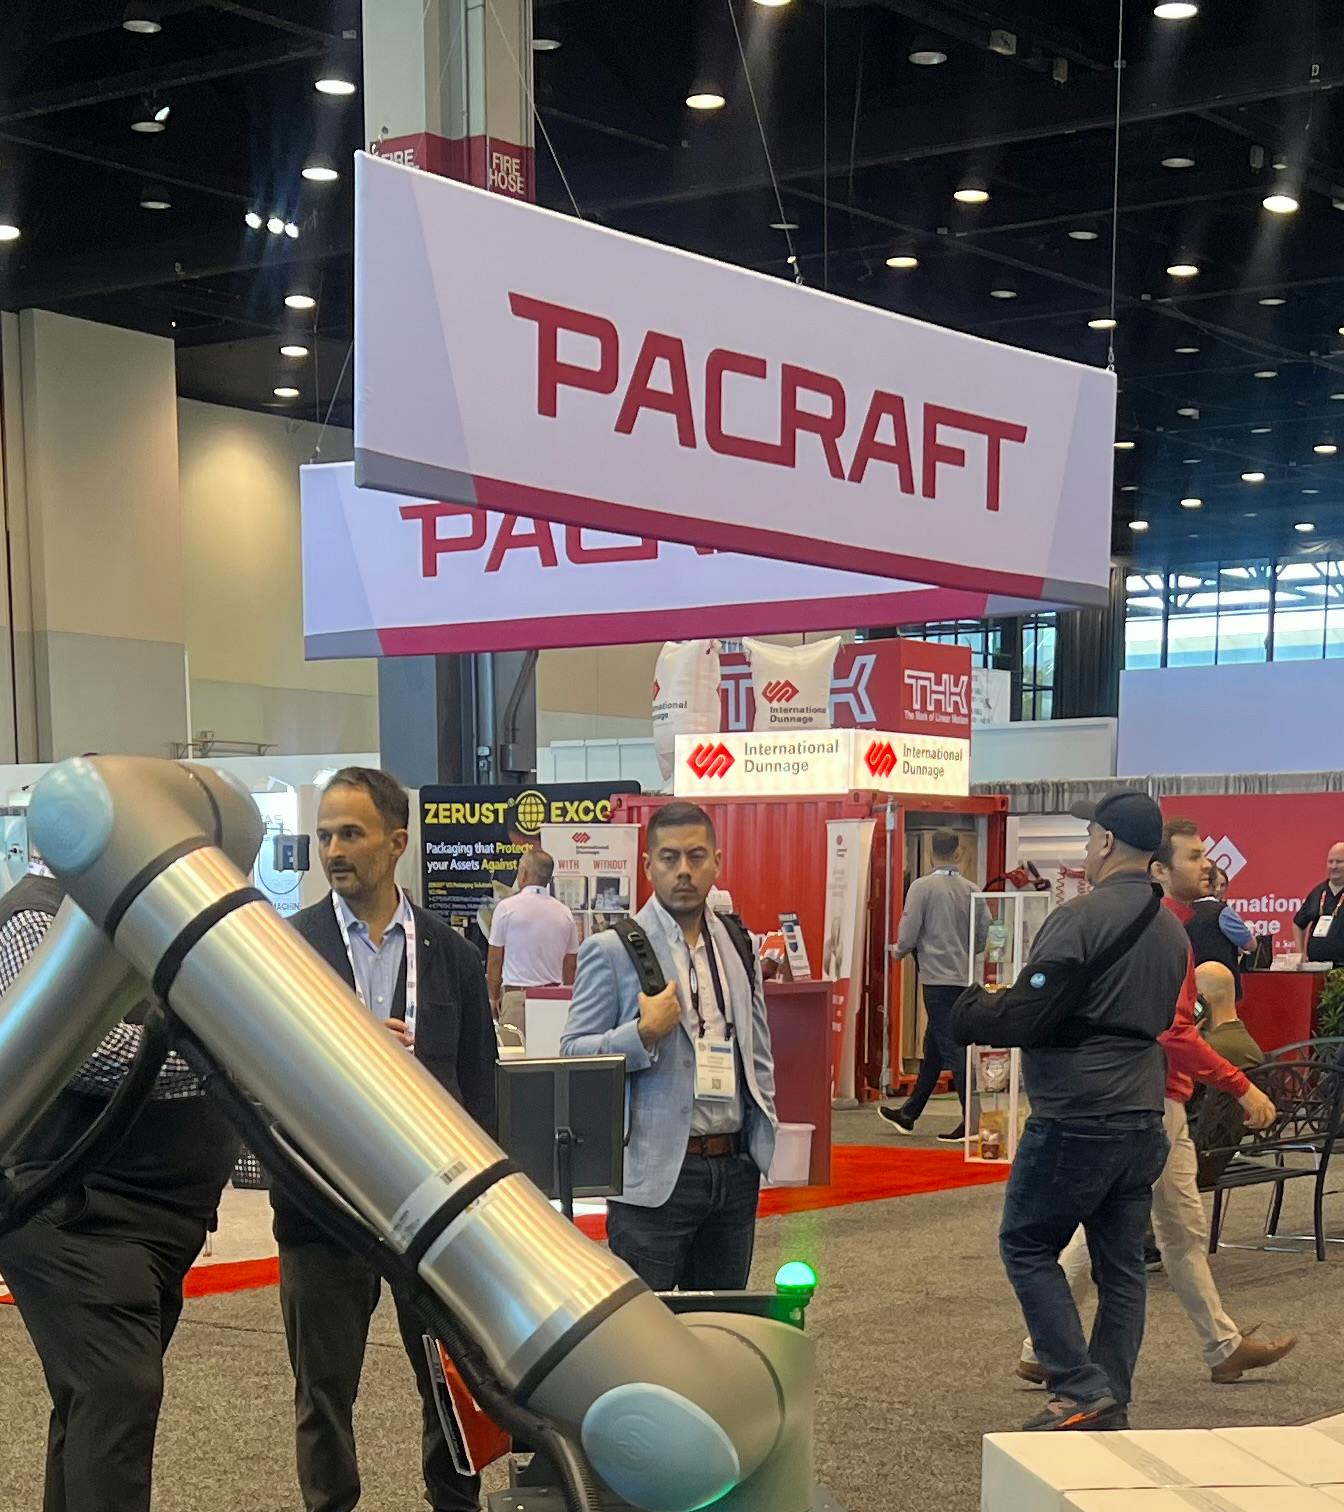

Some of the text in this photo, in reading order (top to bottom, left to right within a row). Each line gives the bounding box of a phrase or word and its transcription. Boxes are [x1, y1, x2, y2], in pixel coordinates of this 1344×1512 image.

[492, 151, 521, 177] FIRE
[488, 168, 525, 195] HOSE
[507, 291, 1027, 512] PACRAFT
[903, 668, 969, 715] THK
[770, 715, 814, 725] Dunnage
[744, 739, 840, 757] International
[903, 743, 963, 762] International
[744, 758, 809, 776] Dunnage
[902, 760, 945, 779] Dunnage
[426, 842, 473, 856] Packaging
[474, 841, 495, 854] that
[426, 858, 518, 874] your Assets Against
[558, 859, 627, 870] WITH WITHOUT
